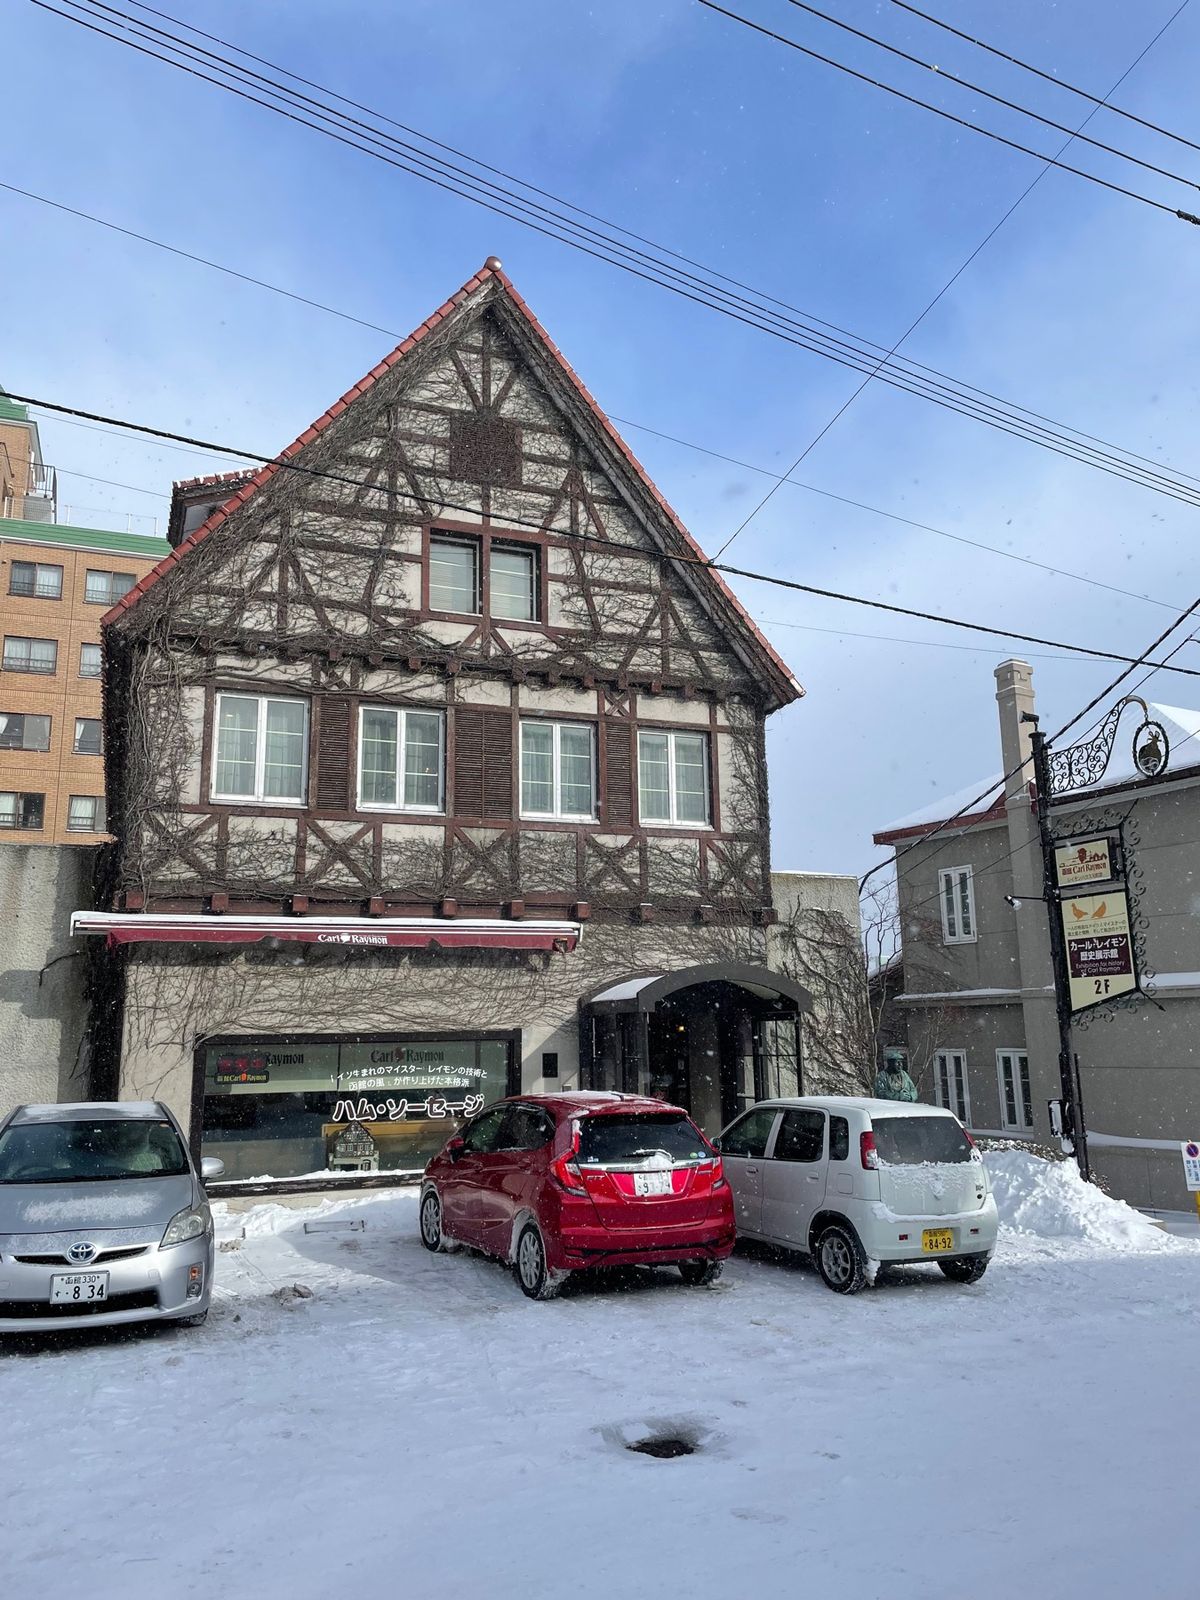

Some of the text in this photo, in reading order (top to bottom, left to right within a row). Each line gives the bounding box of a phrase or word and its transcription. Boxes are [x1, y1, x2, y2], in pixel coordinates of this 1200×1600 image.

[1073, 865, 1085, 874] Carl
[317, 934, 388, 945] Carl Raymon
[1070, 937, 1127, 951] カール・レイモン
[1080, 948, 1119, 961] 歴史展示館
[1075, 962, 1099, 970] Exhibition
[1099, 966, 1121, 974] Raymon
[371, 1050, 445, 1064] Carl Raymon
[332, 1094, 485, 1122] ハム・ソーセージ
[928, 1237, 952, 1250] 84-92
